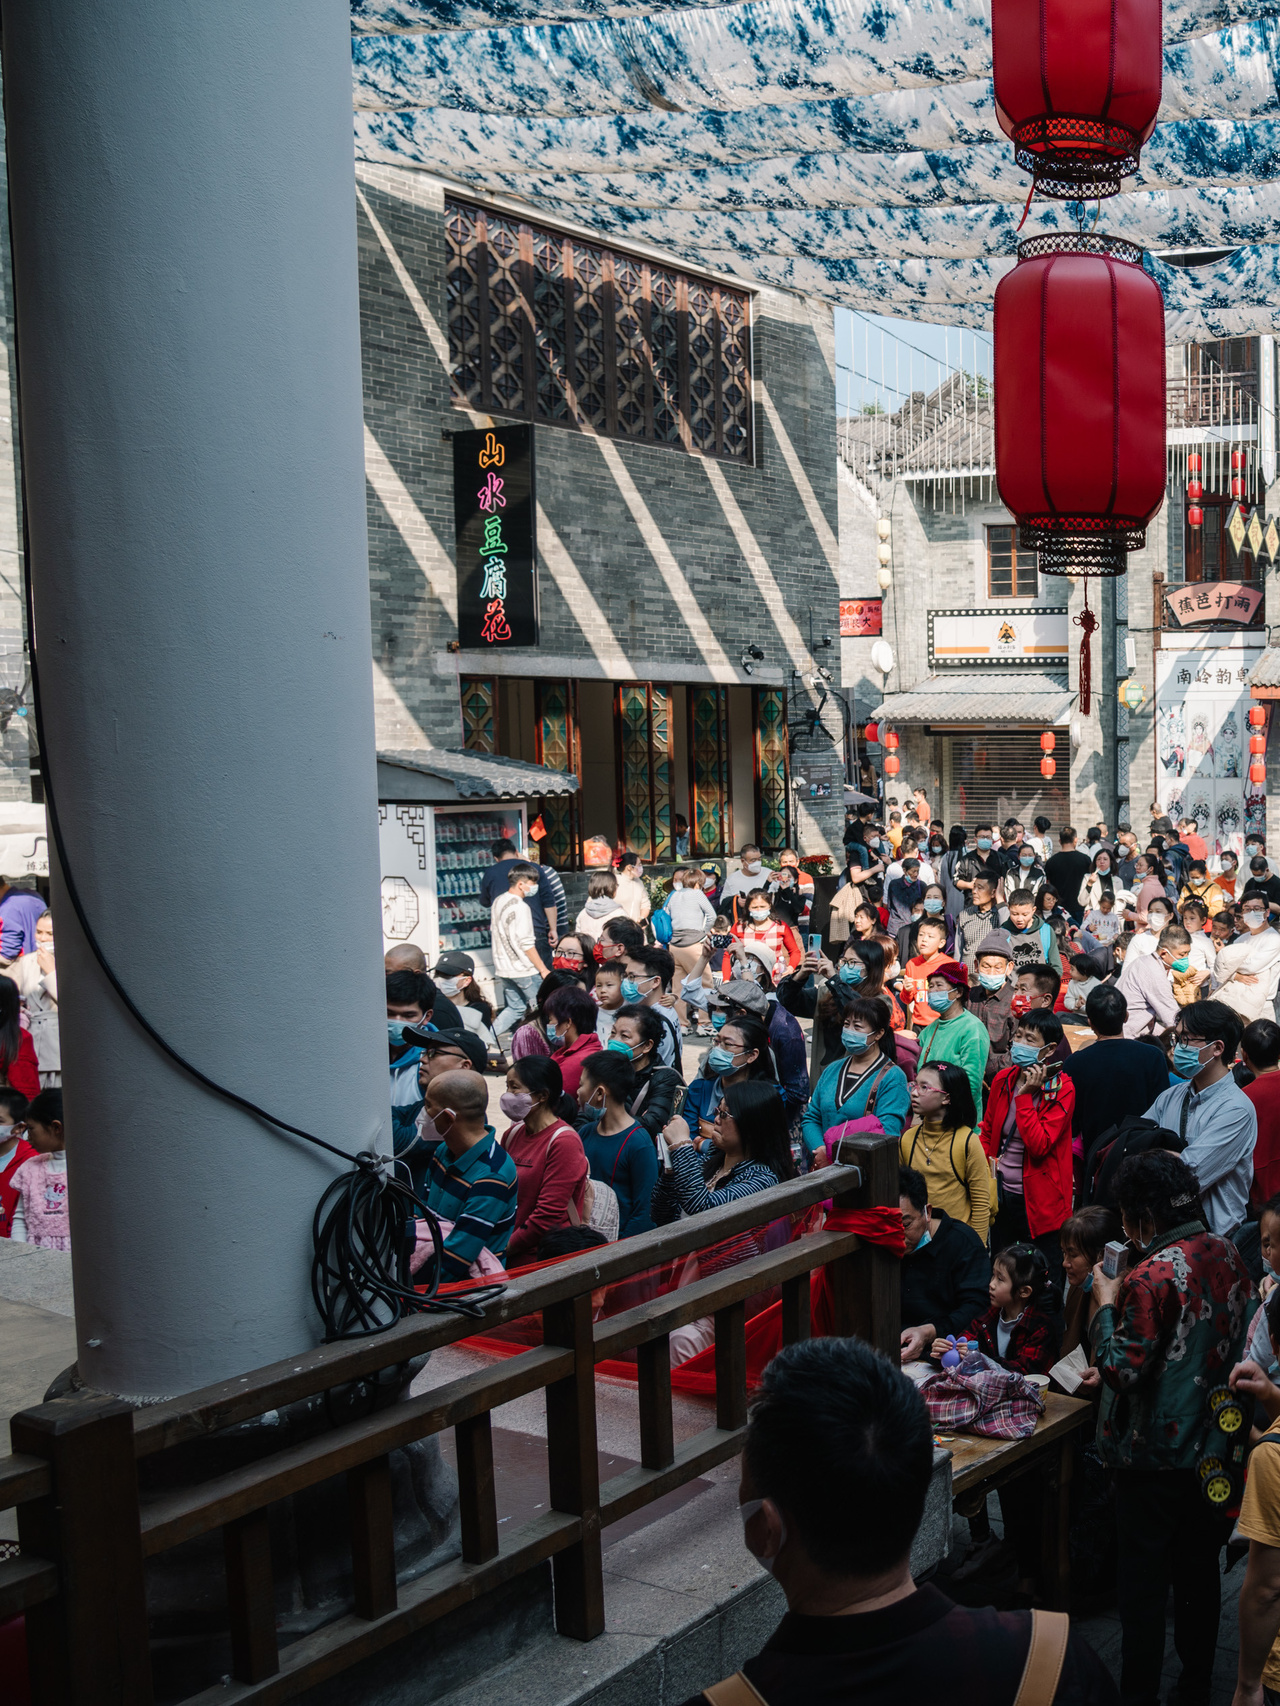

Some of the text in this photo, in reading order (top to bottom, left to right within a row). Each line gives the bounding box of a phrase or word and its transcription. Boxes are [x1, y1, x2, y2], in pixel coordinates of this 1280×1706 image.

[478, 432, 512, 643] 山水豆腐花
